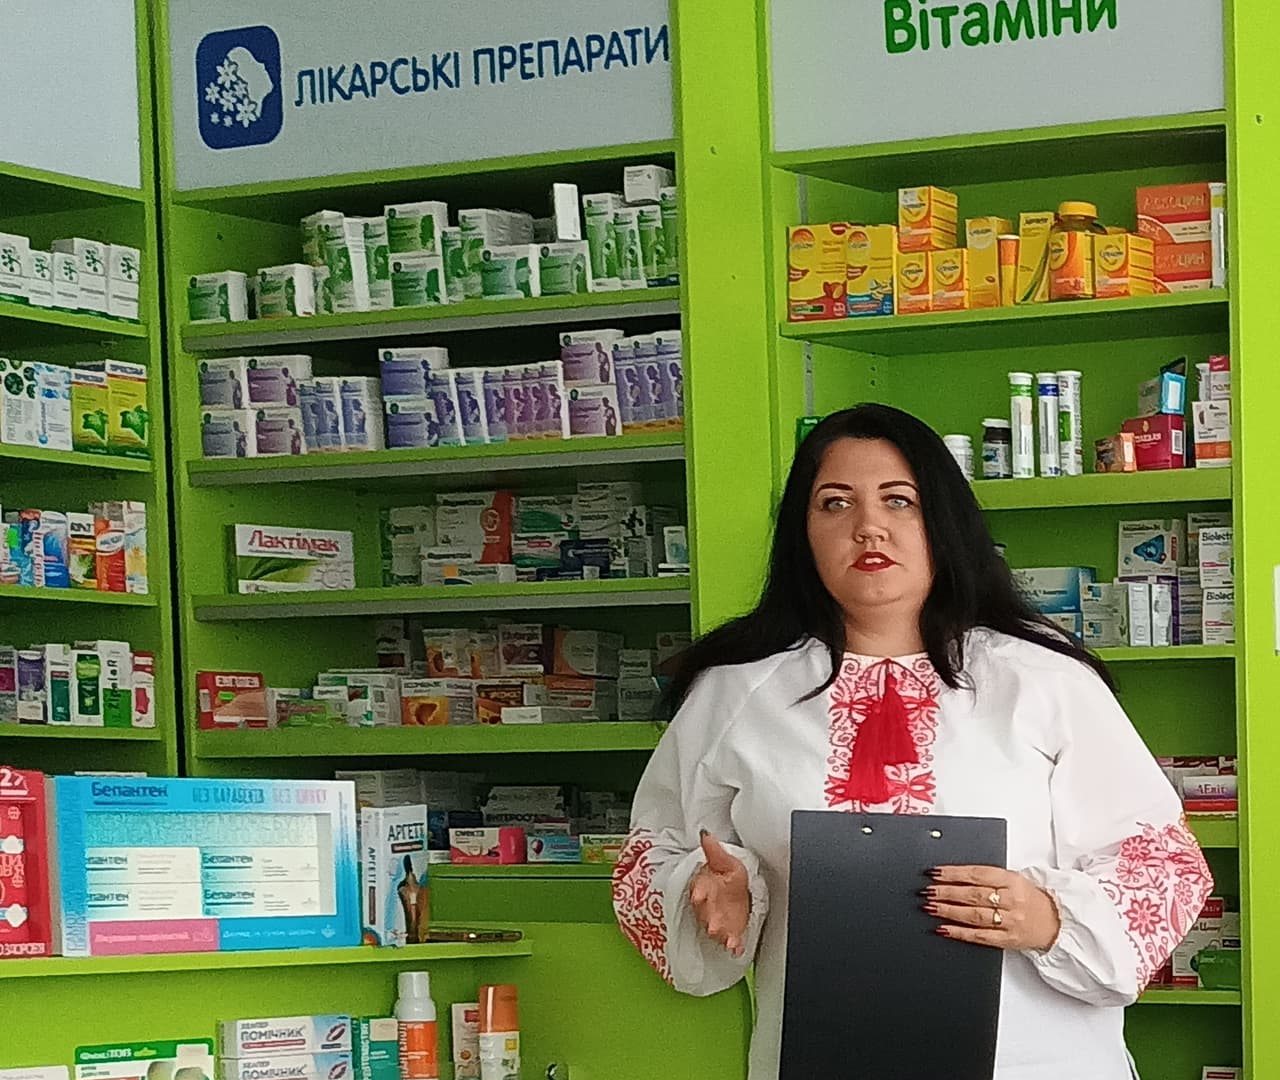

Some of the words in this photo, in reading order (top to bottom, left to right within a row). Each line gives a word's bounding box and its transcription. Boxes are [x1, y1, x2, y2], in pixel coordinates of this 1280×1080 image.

[884, 0, 1117, 53] Вітаміни
[294, 51, 460, 106] ЛІКАРСЬКІ
[473, 24, 670, 85] ПРЕПАРАТИ
[91, 782, 168, 797] Бепантен
